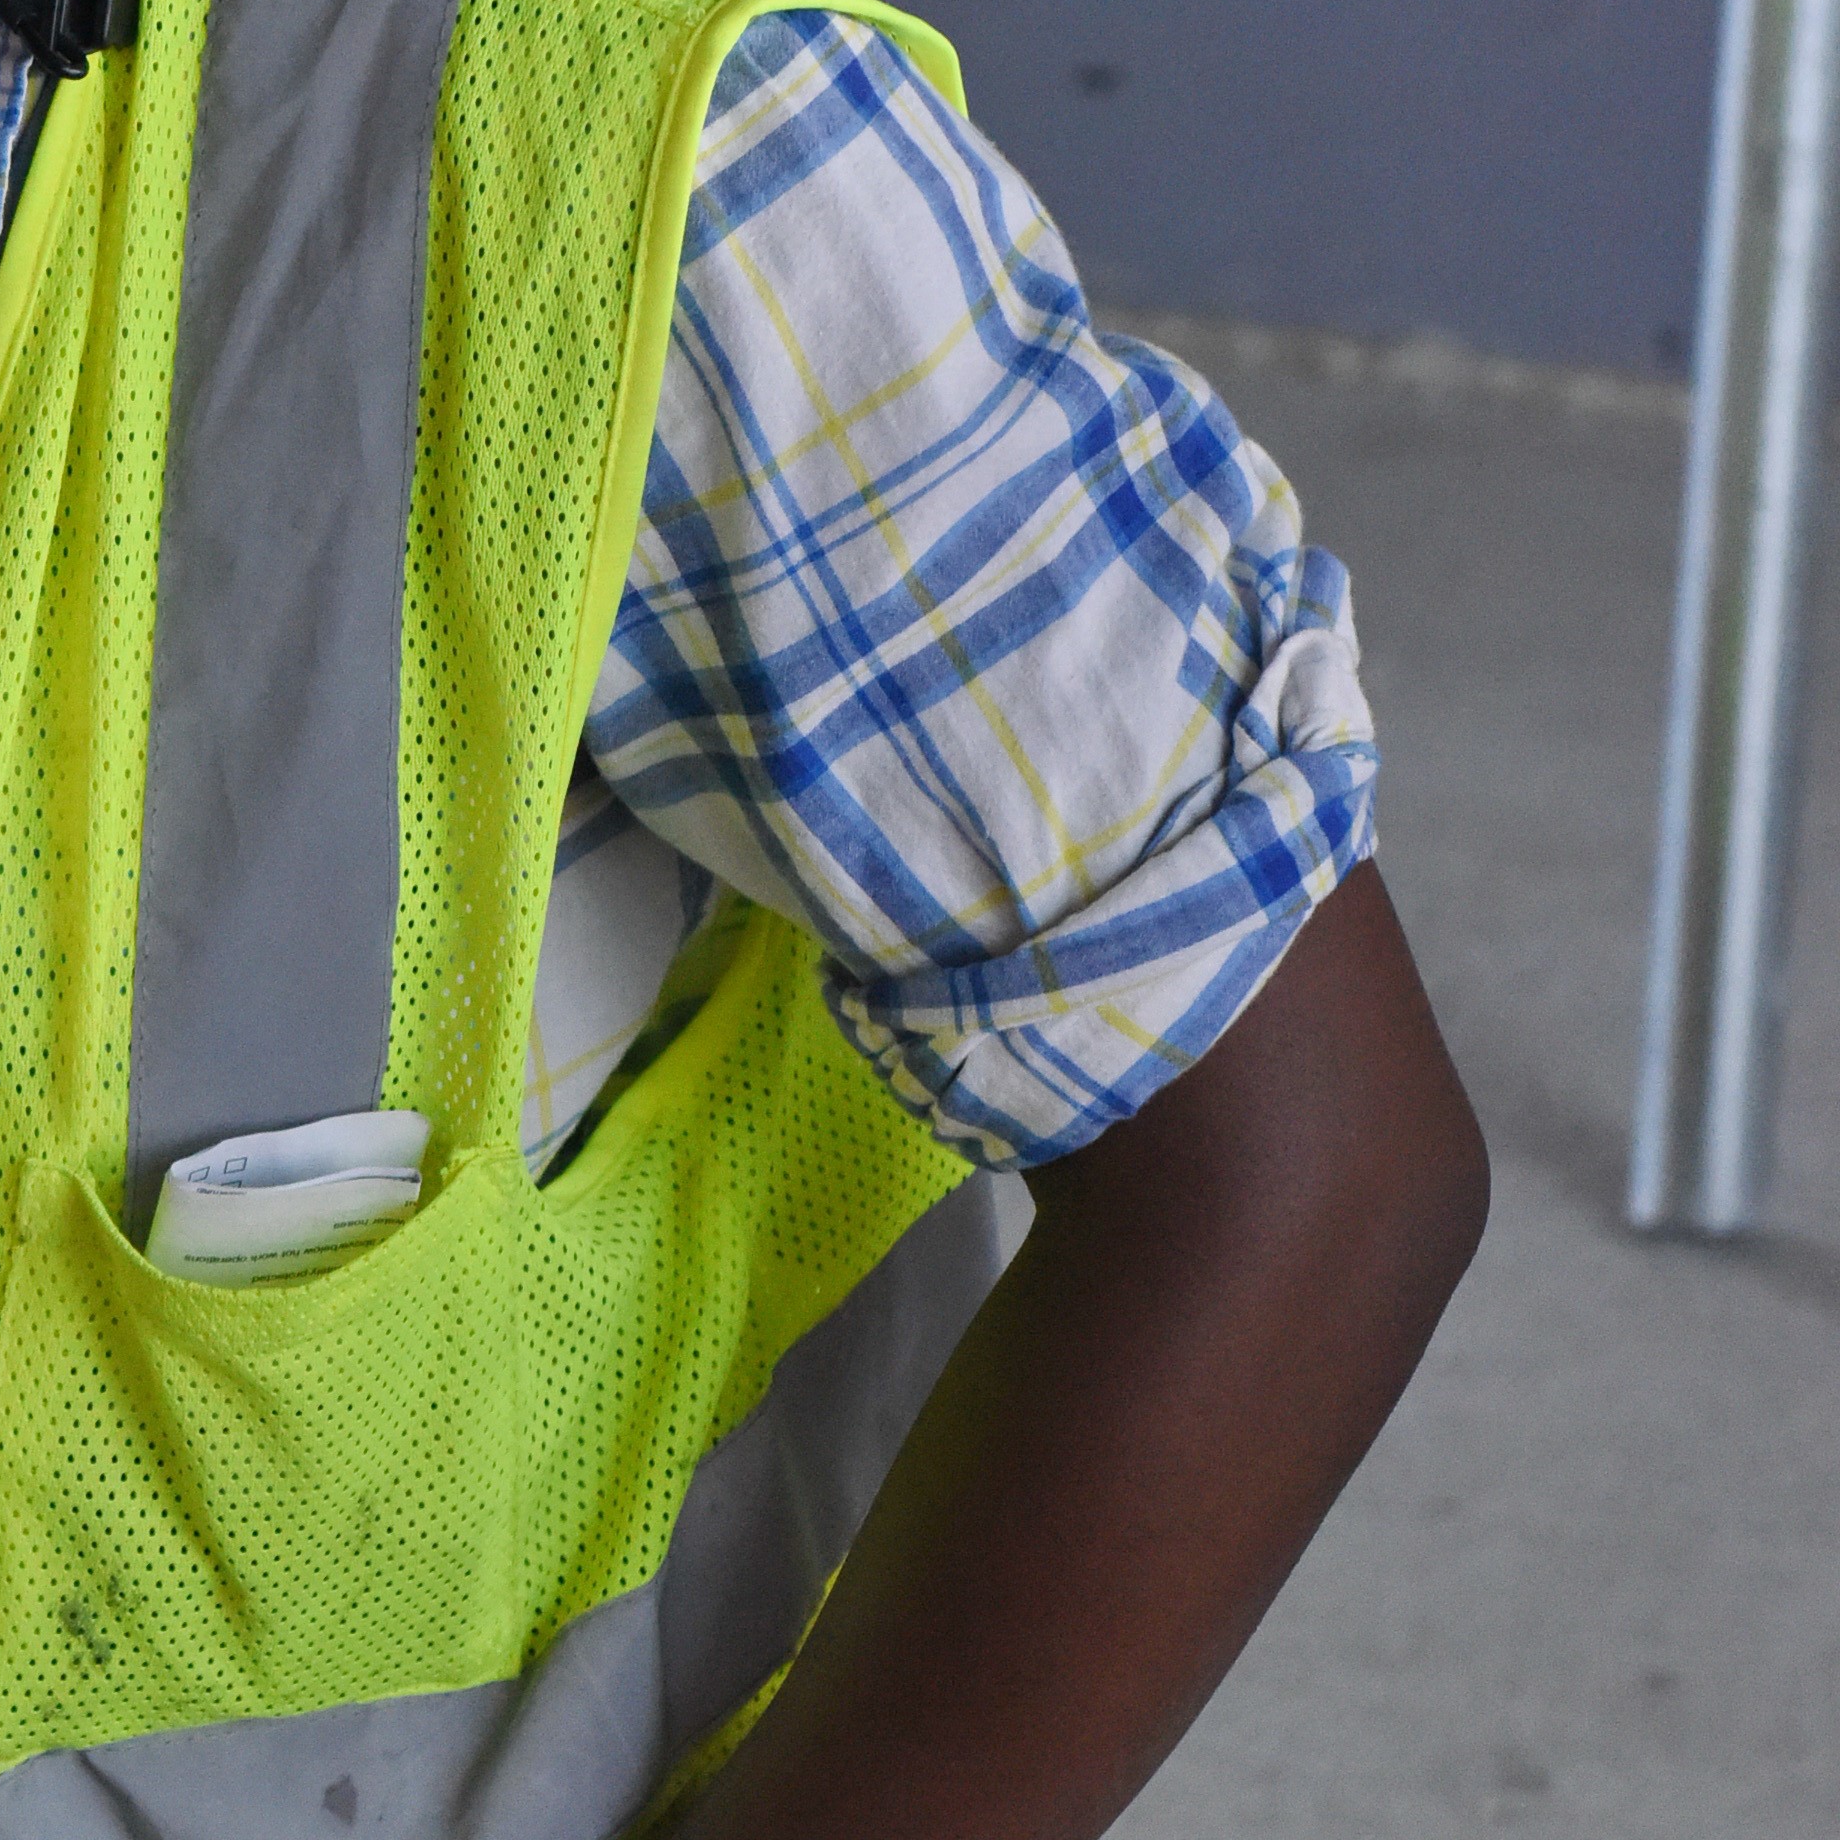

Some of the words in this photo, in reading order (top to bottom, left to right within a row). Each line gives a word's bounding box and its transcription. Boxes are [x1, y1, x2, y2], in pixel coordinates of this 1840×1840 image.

[250, 1252, 278, 1263] work
[281, 1248, 300, 1258] hot
[184, 1254, 248, 1264] operations
